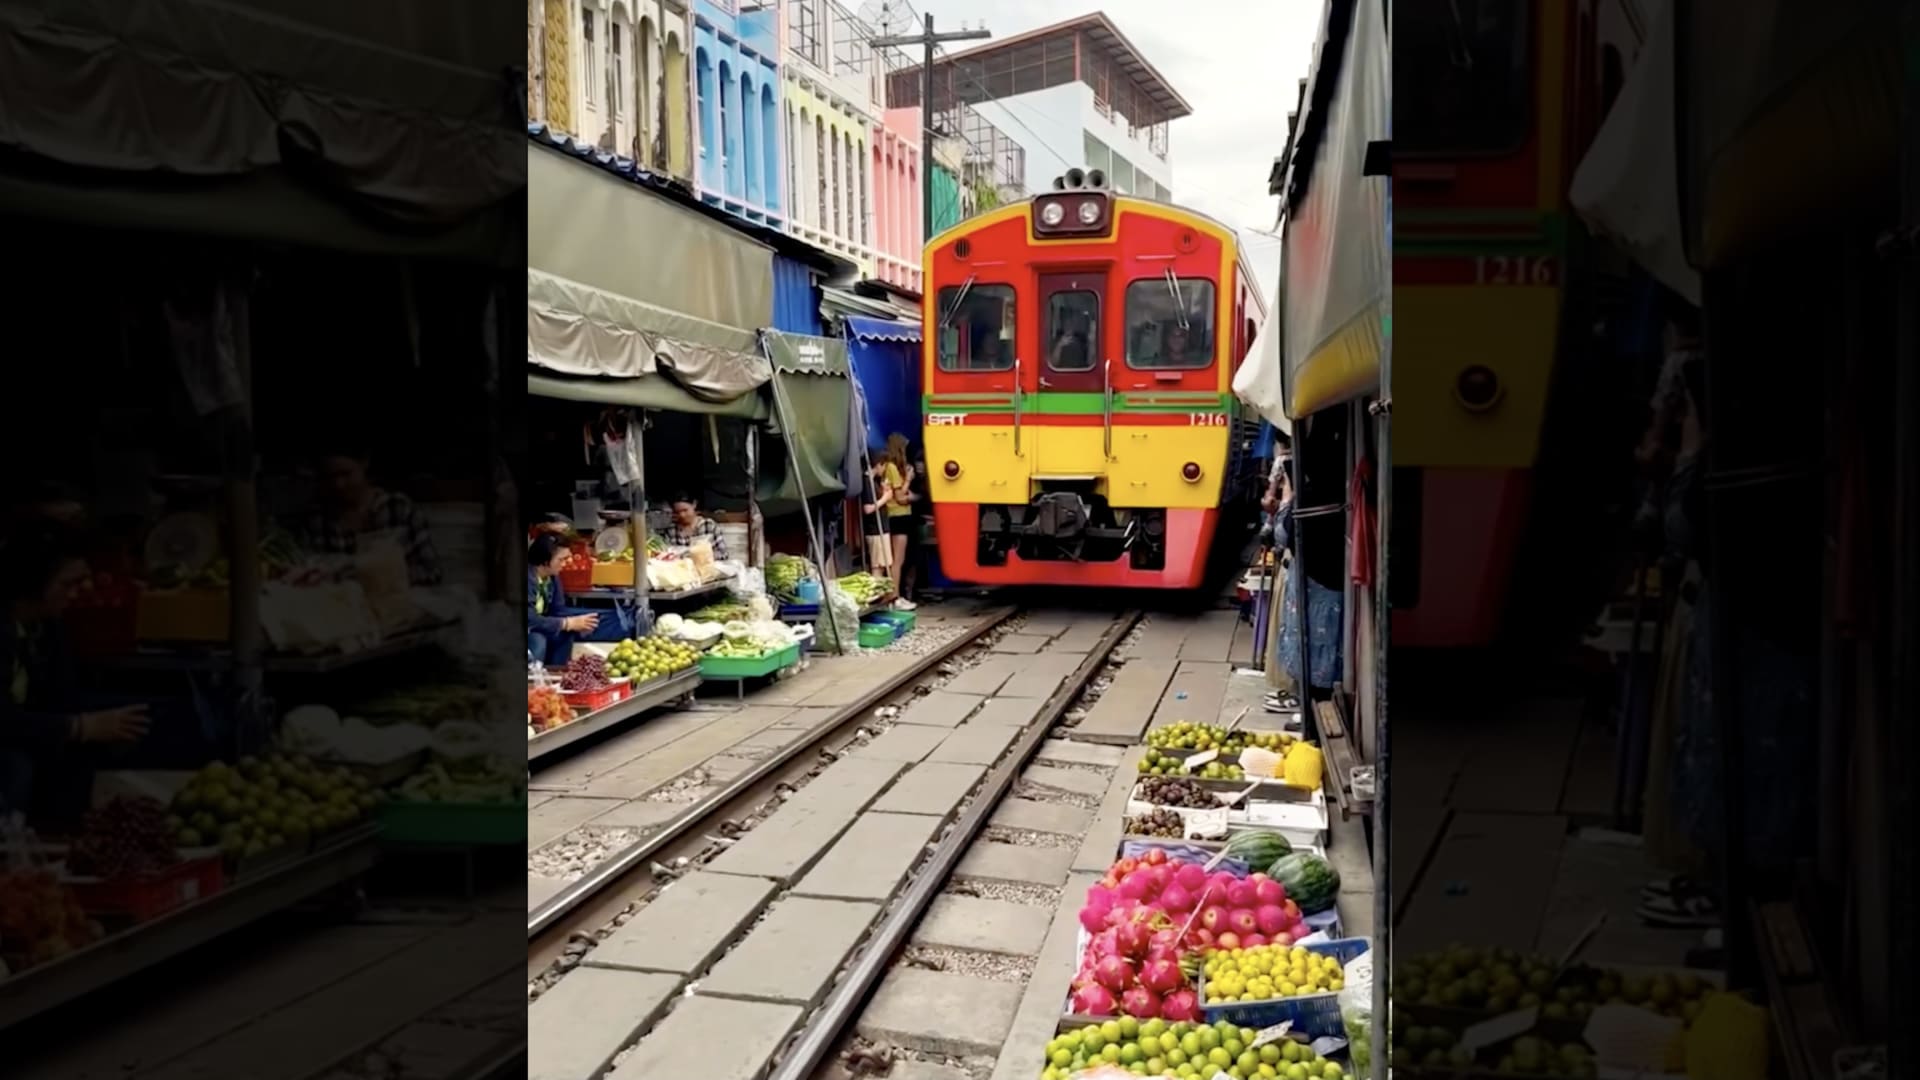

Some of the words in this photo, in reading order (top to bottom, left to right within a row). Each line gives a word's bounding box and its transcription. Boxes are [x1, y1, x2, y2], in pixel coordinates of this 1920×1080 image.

[1474, 255, 1552, 284] 1216
[928, 413, 968, 426] SRT
[1190, 412, 1225, 426] 1216
